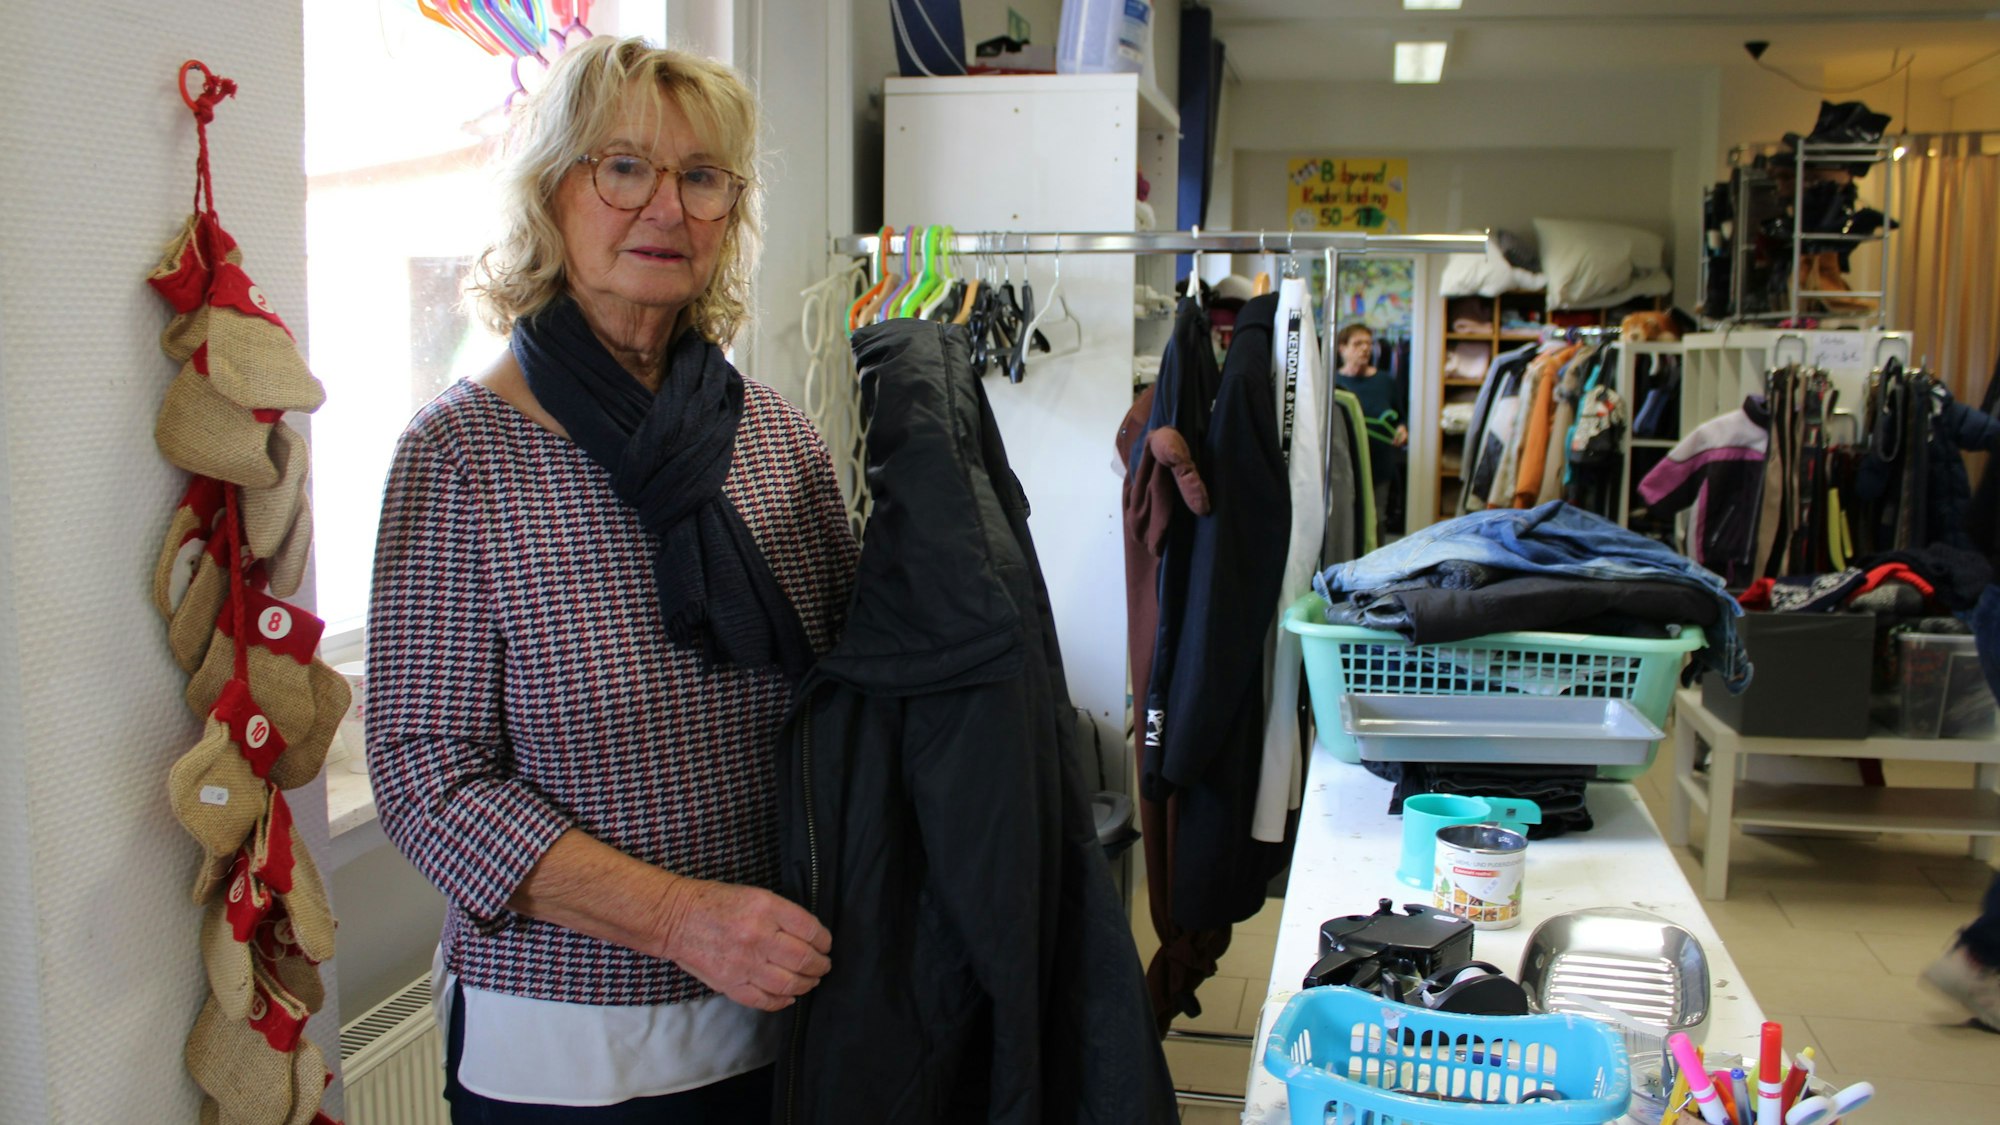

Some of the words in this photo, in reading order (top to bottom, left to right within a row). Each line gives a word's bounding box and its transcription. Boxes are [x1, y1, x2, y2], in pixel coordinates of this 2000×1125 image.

[1286, 330, 1299, 389] KENDALL
[1285, 391, 1296, 400] &
[1283, 404, 1295, 440] KYLIE
[267, 611, 283, 632] 8
[251, 721, 267, 743] 10
